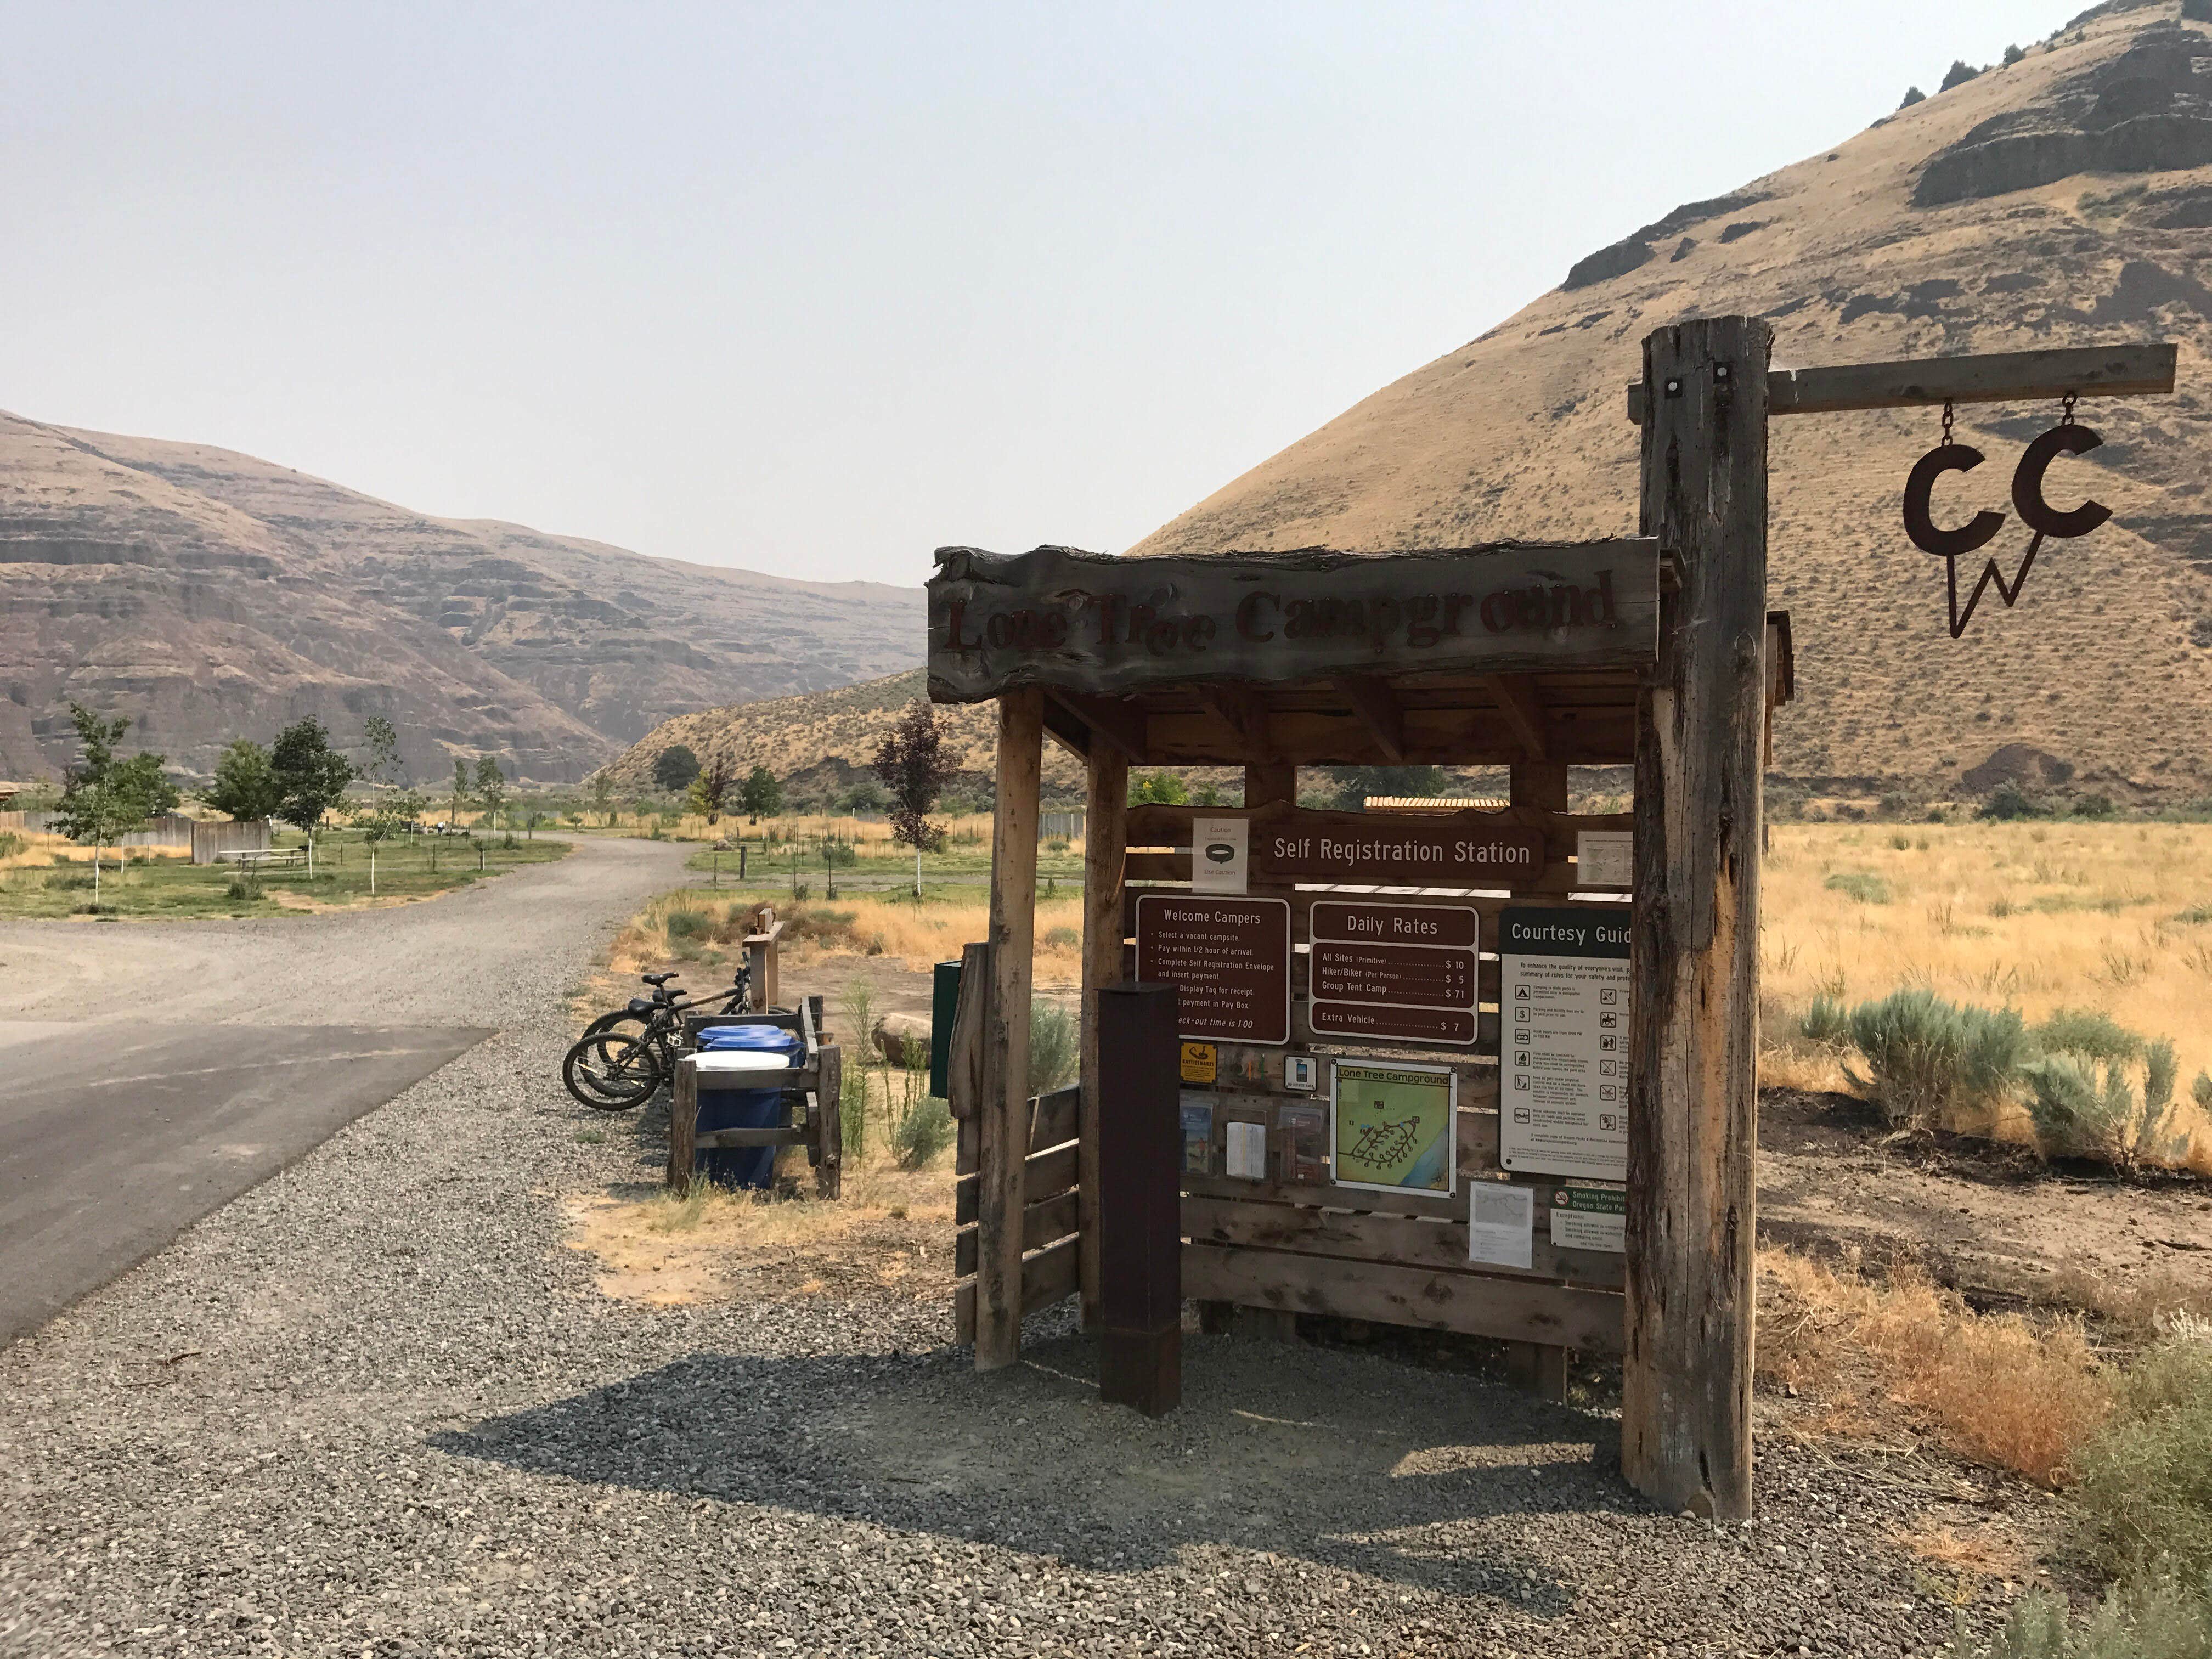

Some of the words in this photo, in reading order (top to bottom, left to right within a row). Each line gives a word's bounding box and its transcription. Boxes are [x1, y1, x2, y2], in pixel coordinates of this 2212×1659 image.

[943, 600, 1067, 651] Lone
[1089, 592, 1216, 657] Tree
[1235, 569, 1614, 655] Campground
[1274, 837, 1311, 859] Self
[1320, 838, 1443, 867] Registration
[1454, 840, 1530, 864] Station
[1164, 909, 1210, 922] Welcome
[1215, 911, 1261, 926] Campers
[1347, 915, 1384, 936] Daily
[1393, 917, 1438, 934] Rates
[1158, 930, 1177, 939] Select
[1512, 923, 1586, 946] Courtesy
[1158, 944, 1170, 953] Pay
[1158, 958, 1187, 967] Complete
[1189, 959, 1201, 967] Self
[1204, 960, 1243, 970] Registration
[1245, 962, 1274, 972] Envelope
[1322, 953, 1332, 962] All
[1335, 953, 1353, 962] Sites
[1445, 960, 1451, 969] $
[1455, 961, 1464, 969] 10
[1192, 972, 1219, 980] payment
[1322, 967, 1362, 978] Hiker/Biker
[1365, 970, 1377, 979] (Per
[1445, 974, 1451, 984] $
[1459, 975, 1464, 984] 5
[1180, 984, 1204, 994] Display
[1205, 985, 1216, 995] Tag
[1322, 981, 1344, 992] Group
[1347, 982, 1362, 991] Tent
[1366, 984, 1386, 995] Camp
[1445, 989, 1451, 998] $
[1455, 990, 1464, 998] 71
[1183, 999, 1210, 1007] payment
[1221, 1000, 1234, 1010] Pay
[1178, 1017, 1207, 1025] eck-out
[1209, 1018, 1226, 1026] time
[1228, 1019, 1235, 1027] is
[1322, 1013, 1343, 1022] Extra
[1347, 1014, 1375, 1024] Vehicle
[1441, 1022, 1447, 1031] $
[1454, 1023, 1459, 1031] 7
[1339, 1069, 1361, 1077] Lone
[1364, 1070, 1384, 1080] Tree
[1386, 1072, 1448, 1085] Campground
[1572, 1190, 1599, 1202] Smoking
[1572, 1200, 1594, 1210] Oregon
